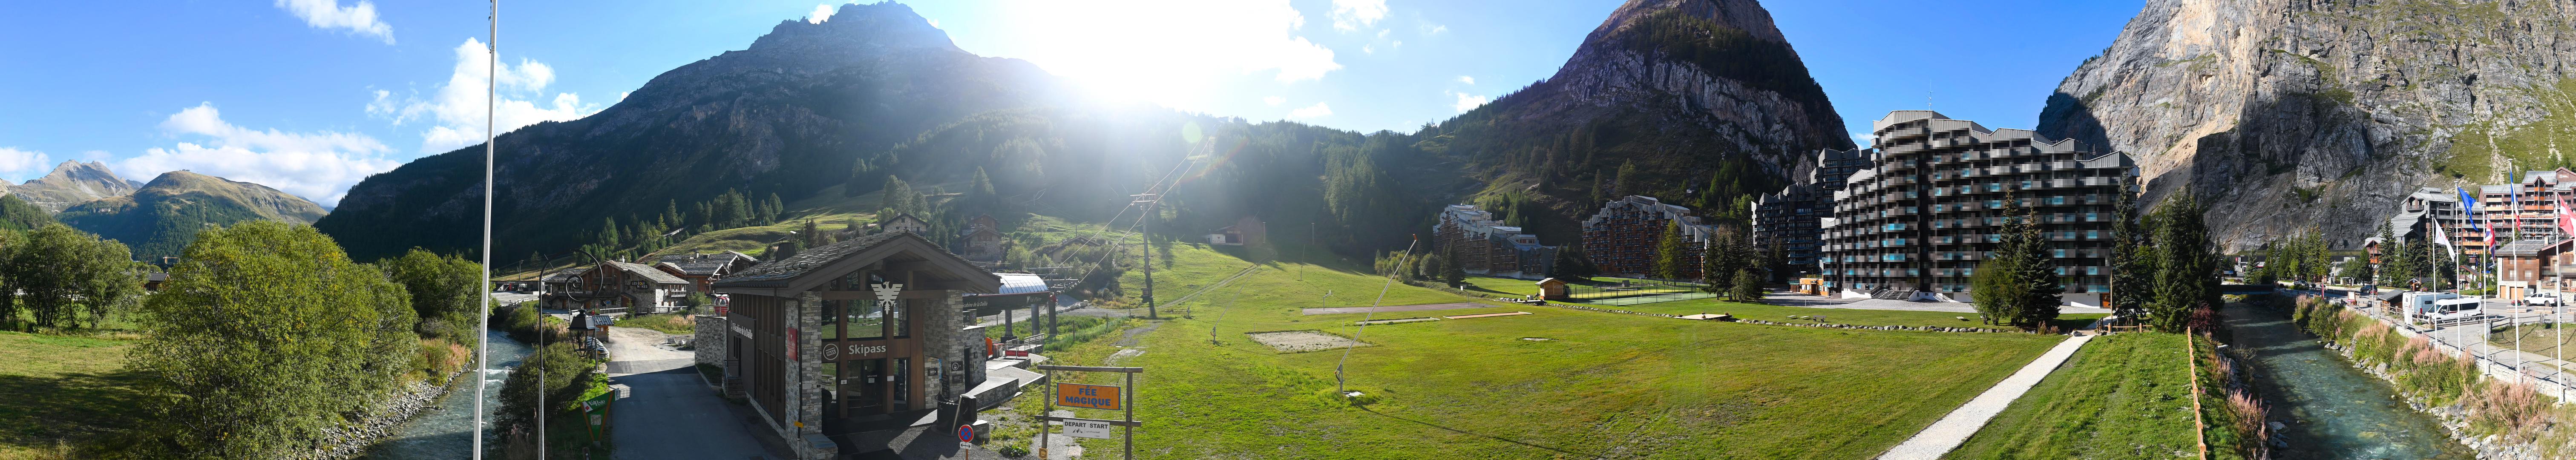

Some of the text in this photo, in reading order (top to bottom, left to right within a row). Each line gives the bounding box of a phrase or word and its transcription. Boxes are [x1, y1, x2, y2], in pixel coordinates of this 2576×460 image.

[849, 344, 886, 356] Skipass
[1079, 385, 1097, 396] FÉE
[1065, 396, 1111, 408] MAGIQUE
